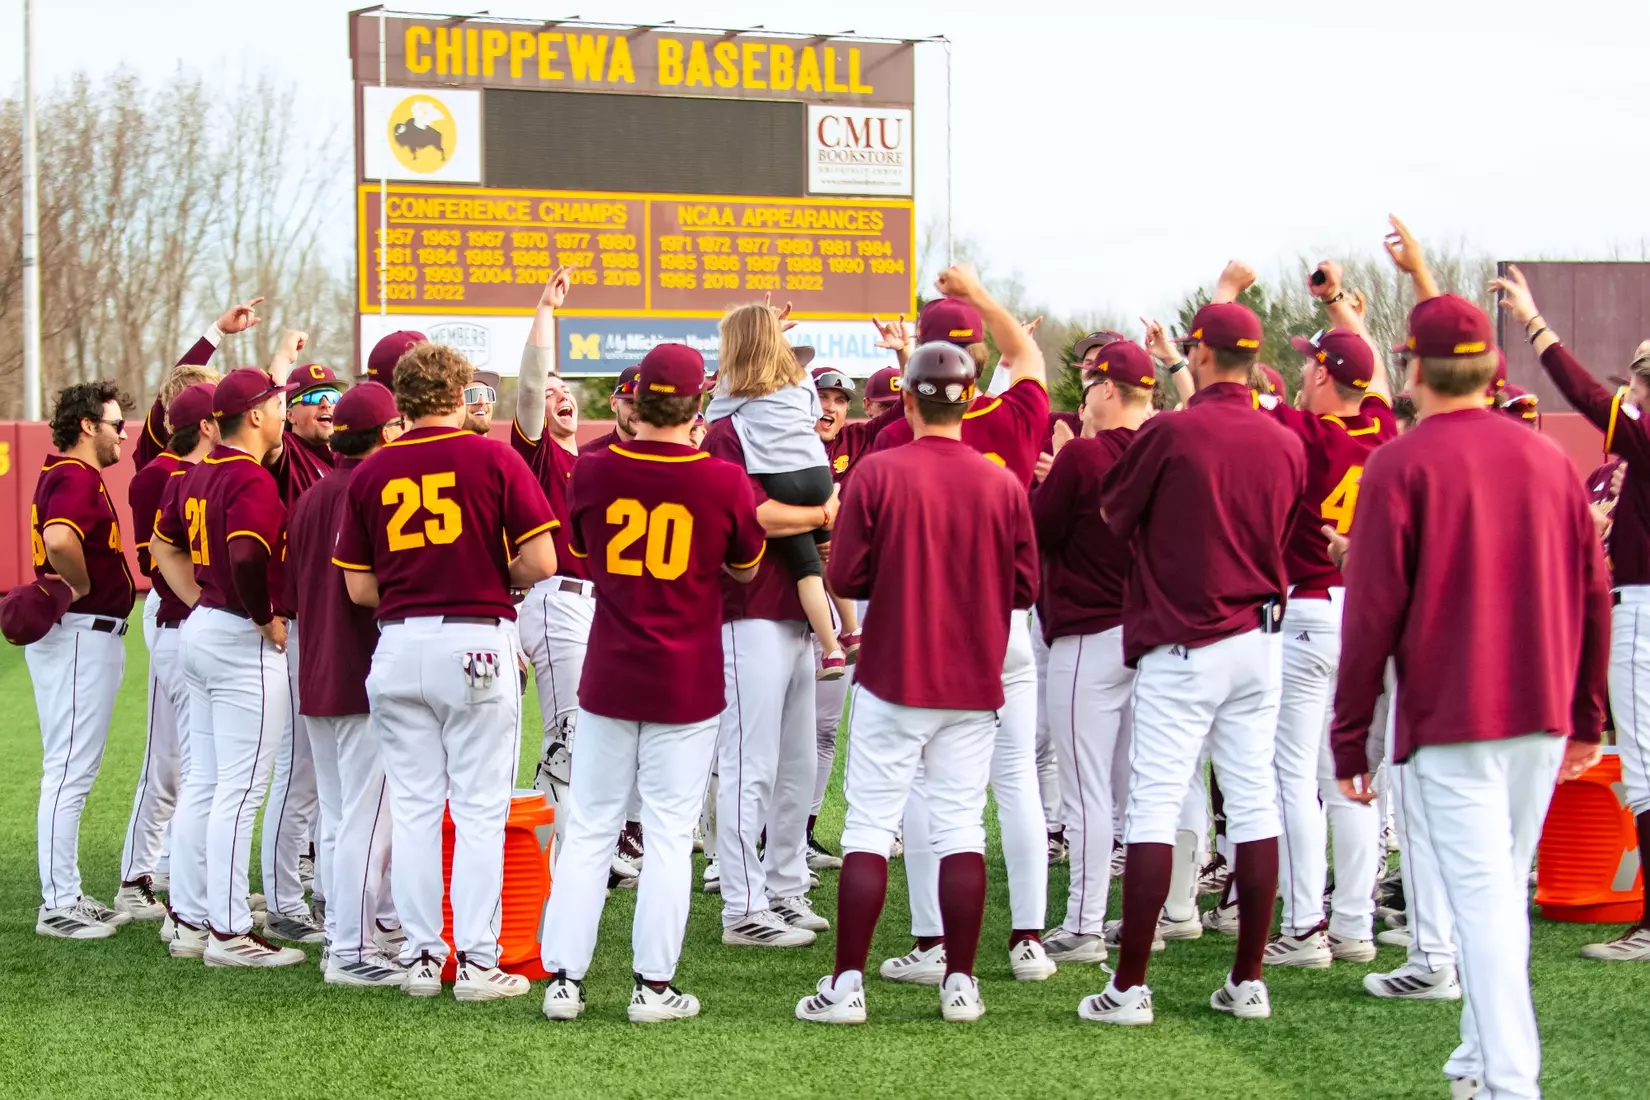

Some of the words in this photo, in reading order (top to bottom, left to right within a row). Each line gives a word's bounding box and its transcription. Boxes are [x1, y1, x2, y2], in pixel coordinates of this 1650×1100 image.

[404, 25, 636, 84] CHIPPEWA
[657, 38, 874, 95] BASEBALL
[817, 114, 904, 150] CMU
[818, 149, 904, 164] BOOKSTORE
[386, 197, 531, 221] CONFERENCE
[538, 201, 628, 224] CHAMPS
[677, 205, 735, 226] NCAA
[741, 208, 885, 231] APPEARANCES
[421, 228, 463, 247] 1963
[466, 230, 506, 248] 1967
[511, 231, 549, 249] 1970
[554, 232, 592, 250] 1977
[596, 233, 637, 251] 1980
[658, 235, 692, 252] 1971
[696, 236, 732, 253] 1972
[736, 237, 771, 254] 1977
[776, 238, 814, 255] 1980
[818, 239, 852, 256] 1981
[856, 240, 893, 257] 1984
[416, 247, 458, 265] 1984
[464, 249, 505, 266] 1985
[658, 253, 697, 270] 1985
[745, 255, 782, 272] 1987
[785, 256, 824, 273] 1988
[828, 257, 865, 274] 1990
[869, 258, 905, 275] 1994
[468, 266, 513, 284] 2004
[568, 269, 598, 285] 015
[603, 269, 642, 287] 2019
[658, 271, 697, 289] 1995
[703, 272, 740, 290] 2019
[745, 273, 781, 290] 2021
[785, 274, 824, 291] 2022
[423, 284, 465, 300] 2022
[430, 327, 487, 347] MEMBERS
[569, 333, 600, 360] M
[788, 333, 893, 359] VALHALL
[310, 365, 326, 379] C
[381, 471, 463, 552] 25
[184, 497, 210, 566] 21
[606, 498, 694, 581] 20
